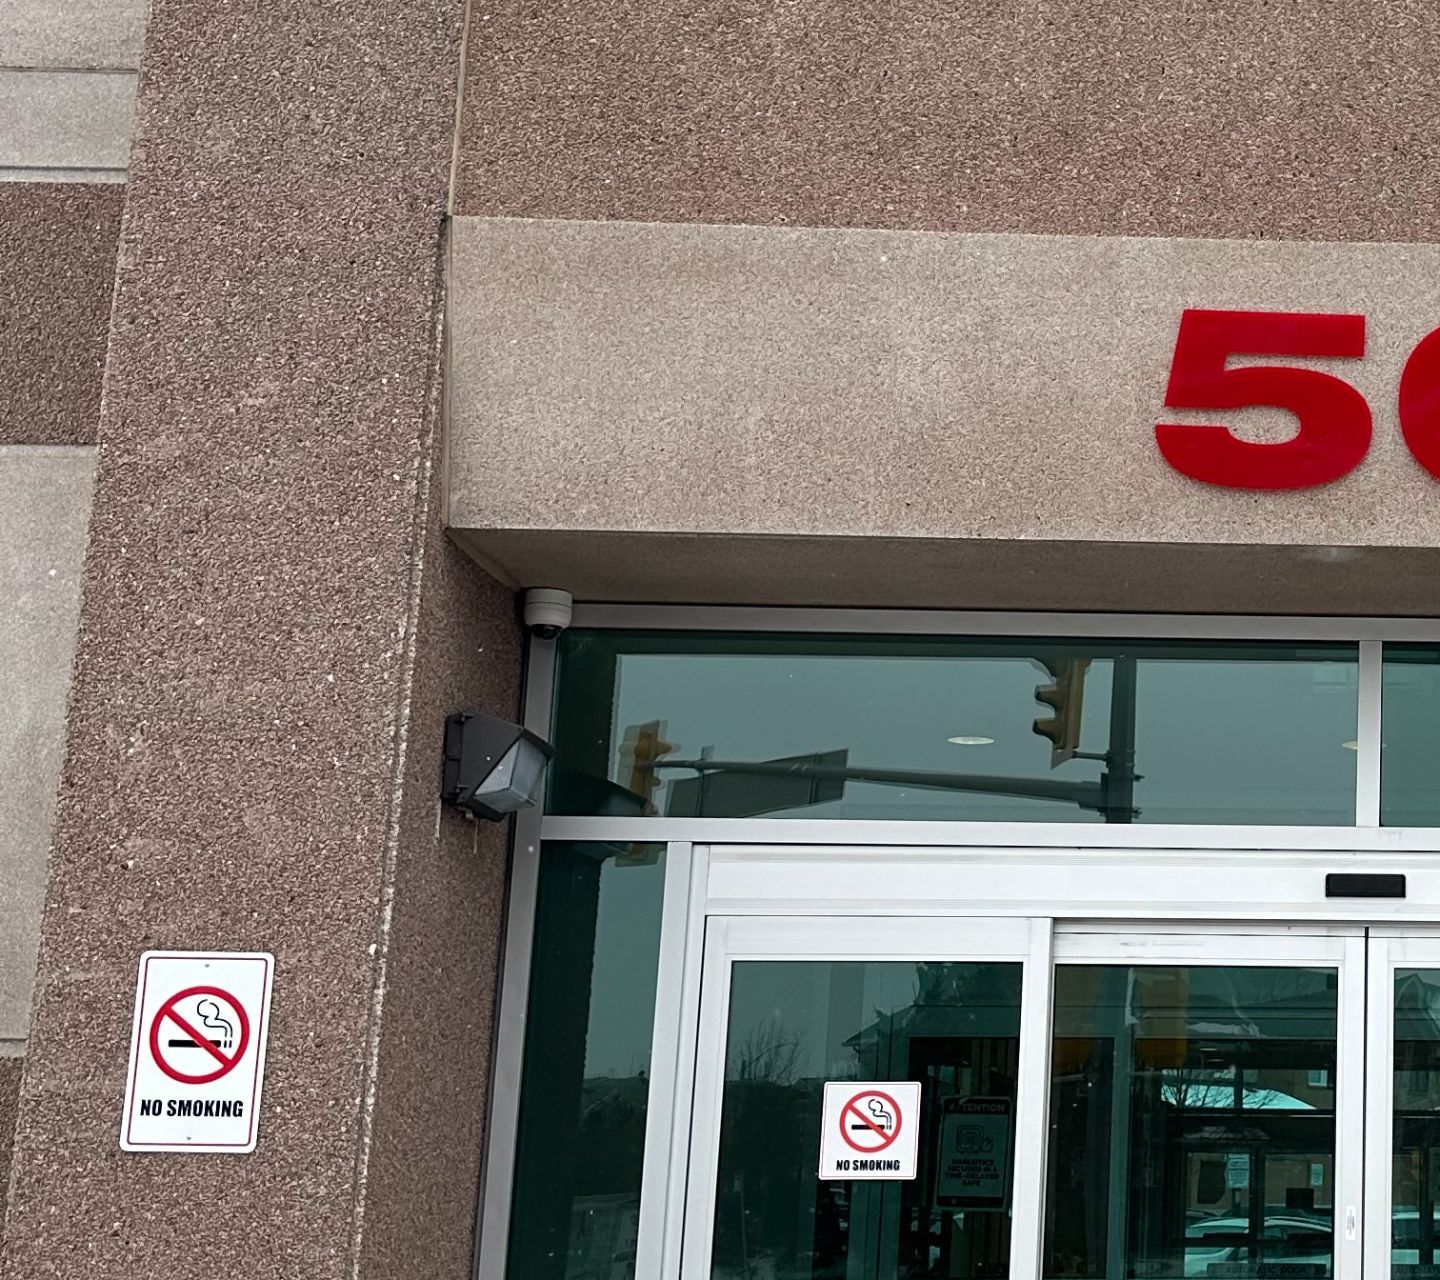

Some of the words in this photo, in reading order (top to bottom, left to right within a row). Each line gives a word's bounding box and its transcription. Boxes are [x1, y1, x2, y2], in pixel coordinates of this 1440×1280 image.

[140, 1099, 163, 1117] NO
[166, 1099, 244, 1118] SMOKING
[836, 1159, 850, 1171] NO
[852, 1159, 901, 1171] SMOKING
